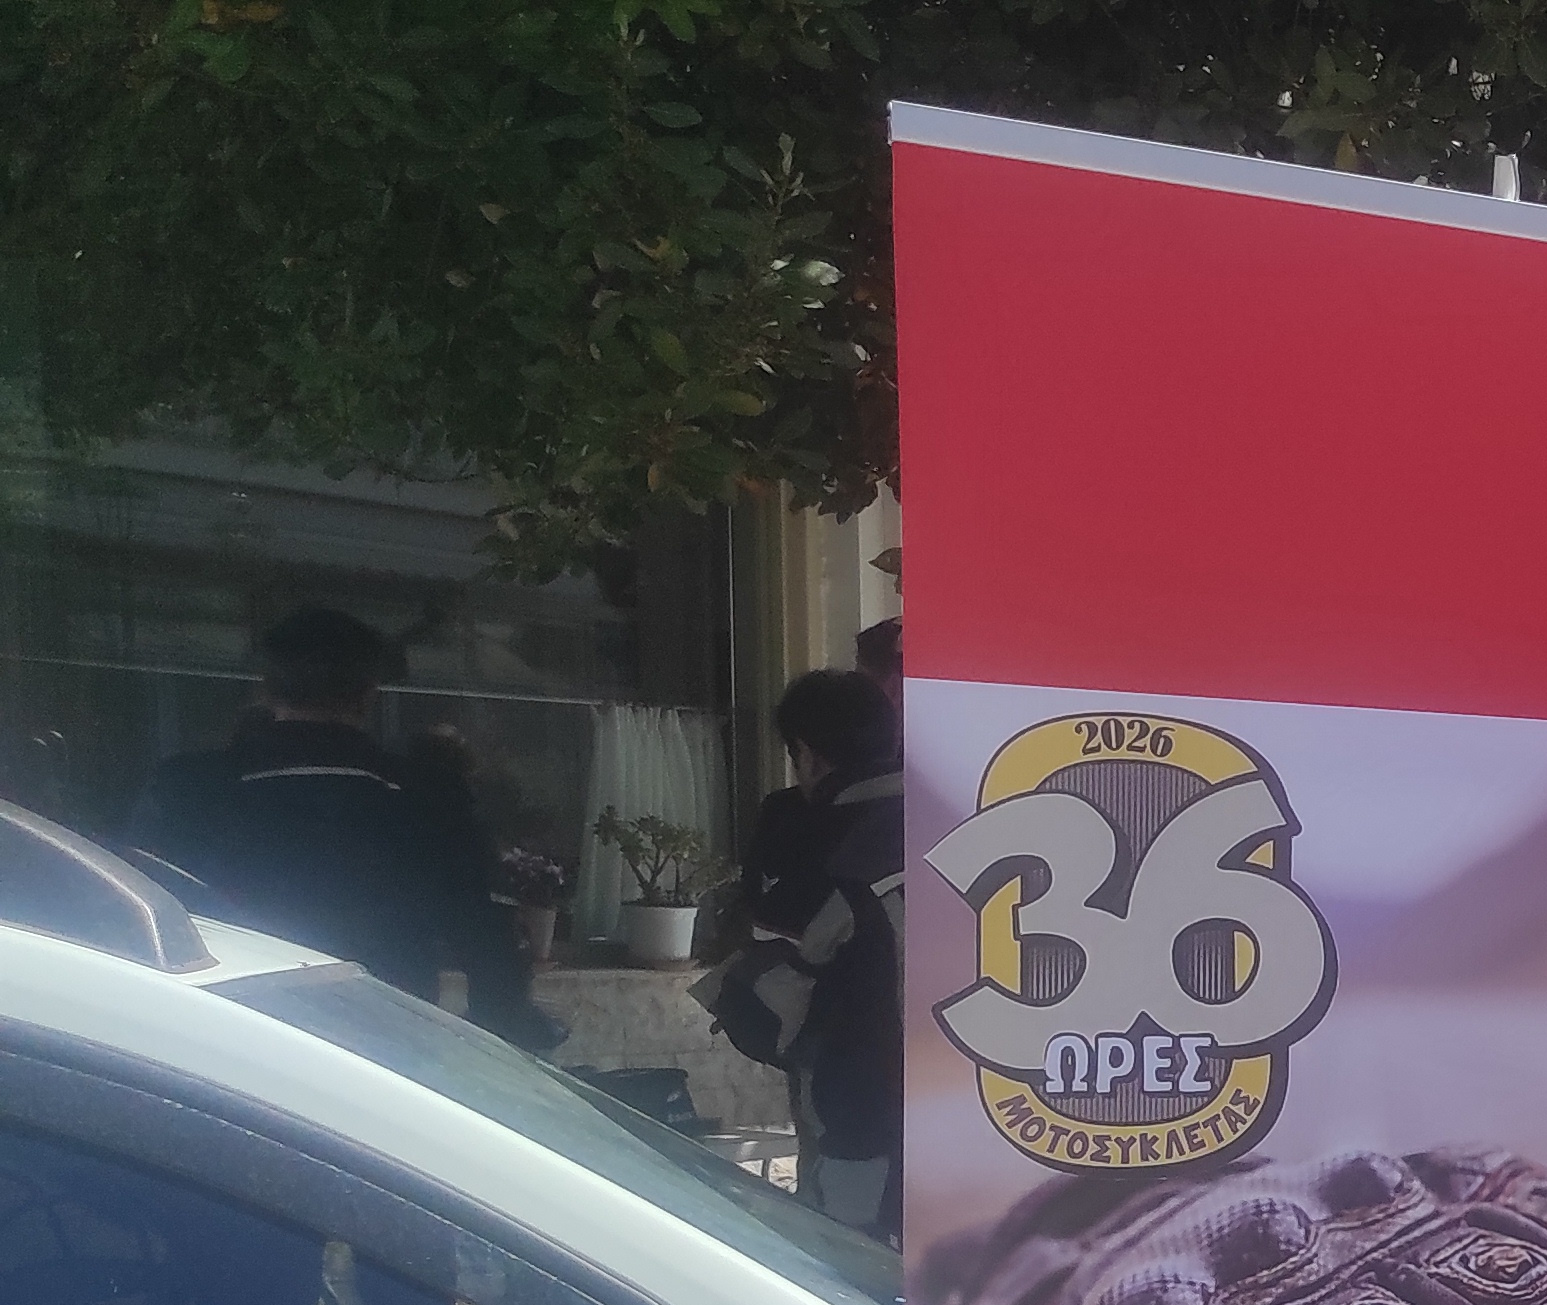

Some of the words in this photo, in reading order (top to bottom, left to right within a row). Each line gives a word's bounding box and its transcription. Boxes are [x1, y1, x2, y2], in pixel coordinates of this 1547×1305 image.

[1074, 717, 1175, 758] 2026
[923, 779, 1327, 1071] 36
[1044, 1034, 1212, 1094] ΩΡΕΣ
[994, 1087, 1262, 1165] ΜΟΤΟΣΥΚΛΕΤΑΣ
